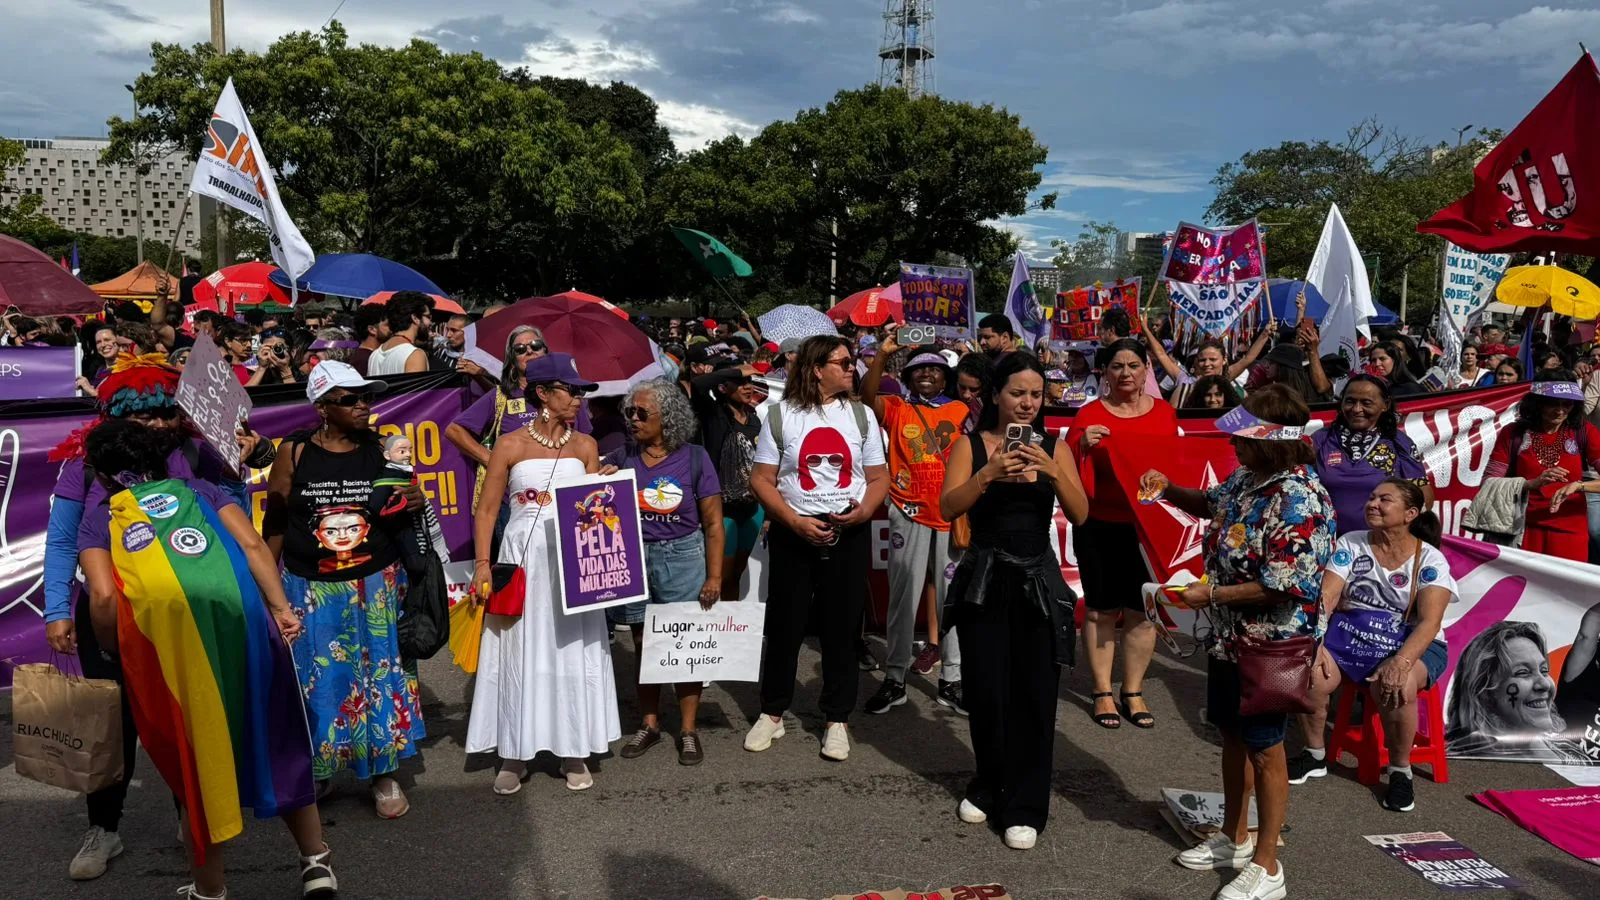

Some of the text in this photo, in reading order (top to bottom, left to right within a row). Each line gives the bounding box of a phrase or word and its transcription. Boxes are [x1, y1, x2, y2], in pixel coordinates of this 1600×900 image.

[208, 175, 264, 209] TRABALHADO
[903, 279, 965, 297] TODOS POR
[906, 296, 961, 318] TODAS
[1171, 282, 1259, 320] MERCADORIAS
[177, 380, 196, 416] LUTA
[193, 395, 209, 431] PELA
[207, 407, 222, 443] VIDA
[575, 523, 626, 559] PELA
[578, 551, 628, 576] VIDA DAS
[579, 570, 631, 593] MULHERES
[652, 615, 749, 638] Lugar de mulher
[675, 634, 718, 649] é onde
[1352, 649, 1373, 657] Ligue
[659, 651, 724, 675] ela quiser
[17, 723, 83, 750] RIACHUELO
